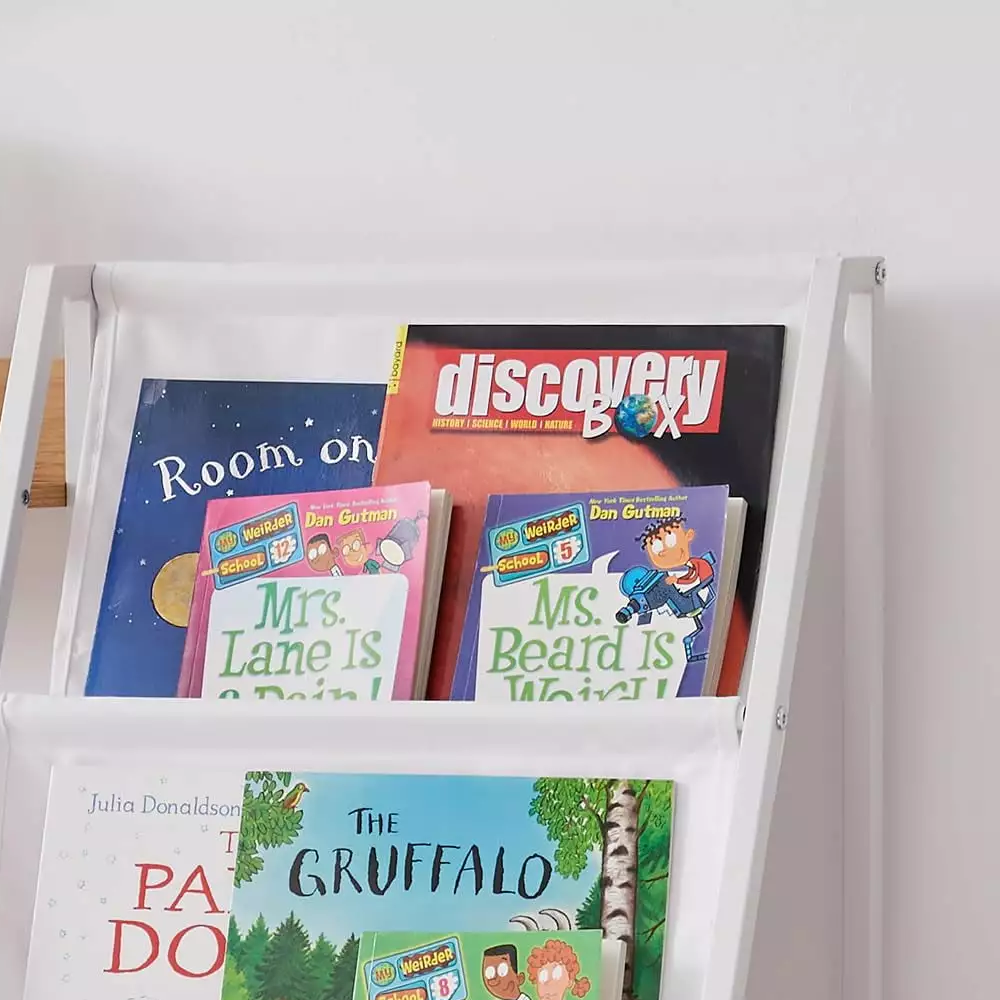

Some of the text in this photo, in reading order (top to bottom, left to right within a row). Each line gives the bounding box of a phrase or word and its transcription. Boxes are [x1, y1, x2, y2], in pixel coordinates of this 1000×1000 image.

[391, 341, 403, 377] bayard
[433, 351, 721, 426] discovery
[432, 418, 574, 430] HISTORY SCIENCE WORLD NATURE
[153, 435, 378, 502] Room on
[305, 508, 398, 528] Dan Gutman
[589, 503, 681, 520] Dan Gutman
[274, 540, 290, 559] 12
[560, 541, 572, 560] 5
[254, 581, 346, 634] Mrs.
[528, 577, 602, 630] Ms.
[218, 627, 382, 679] Lane Is
[486, 624, 676, 675] Beard Is
[87, 793, 241, 817] Julia Donaldson
[348, 807, 400, 835] THE
[133, 863, 230, 914] PA
[288, 841, 553, 900] GRUFFALO
[438, 978, 450, 997] 8
